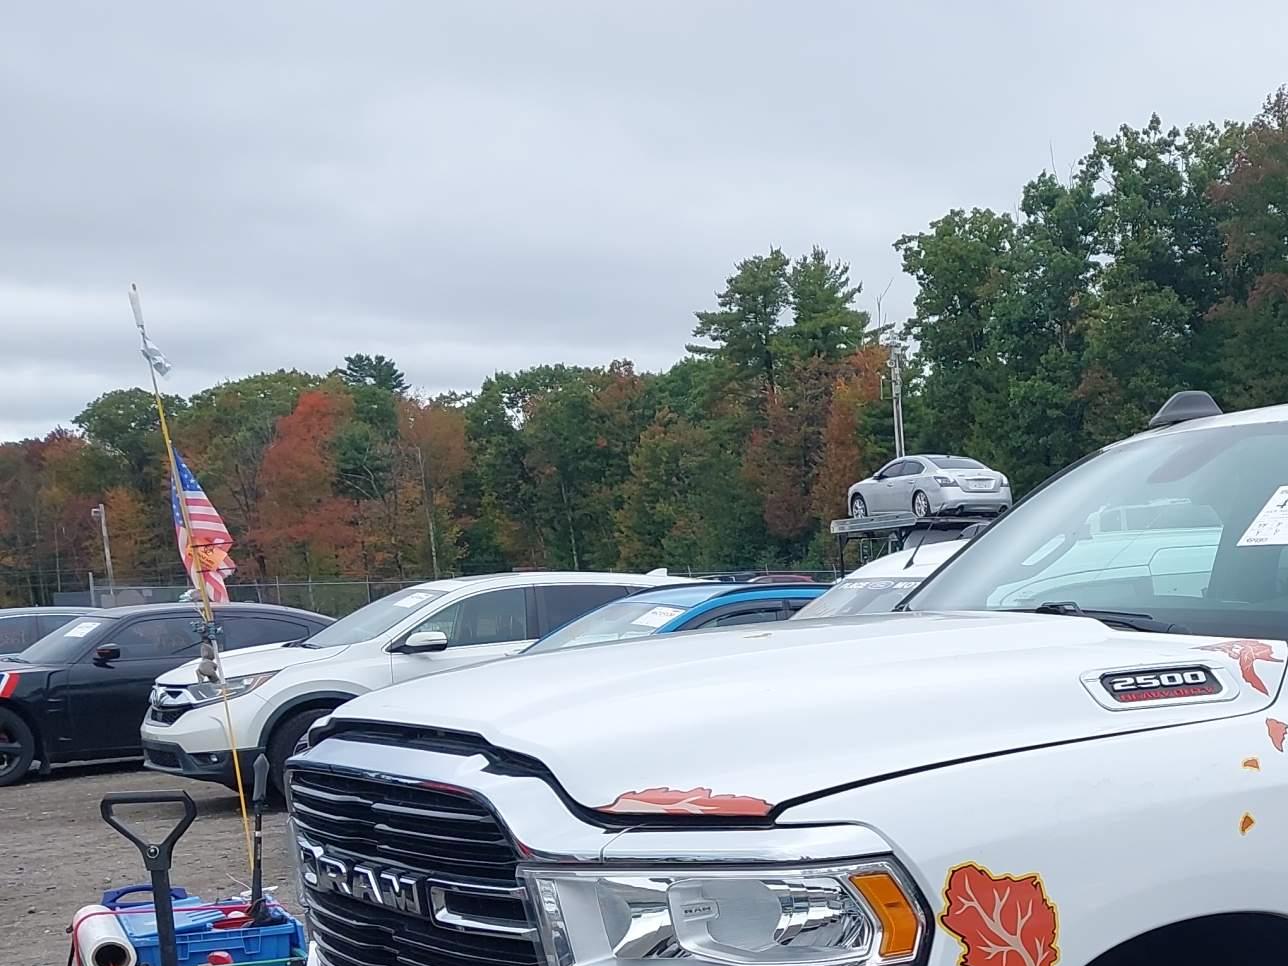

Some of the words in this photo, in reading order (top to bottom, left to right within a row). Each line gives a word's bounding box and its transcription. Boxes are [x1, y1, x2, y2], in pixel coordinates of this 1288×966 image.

[1112, 670, 1207, 691] 2500
[319, 855, 421, 915] RAM
[684, 906, 712, 914] RAM
